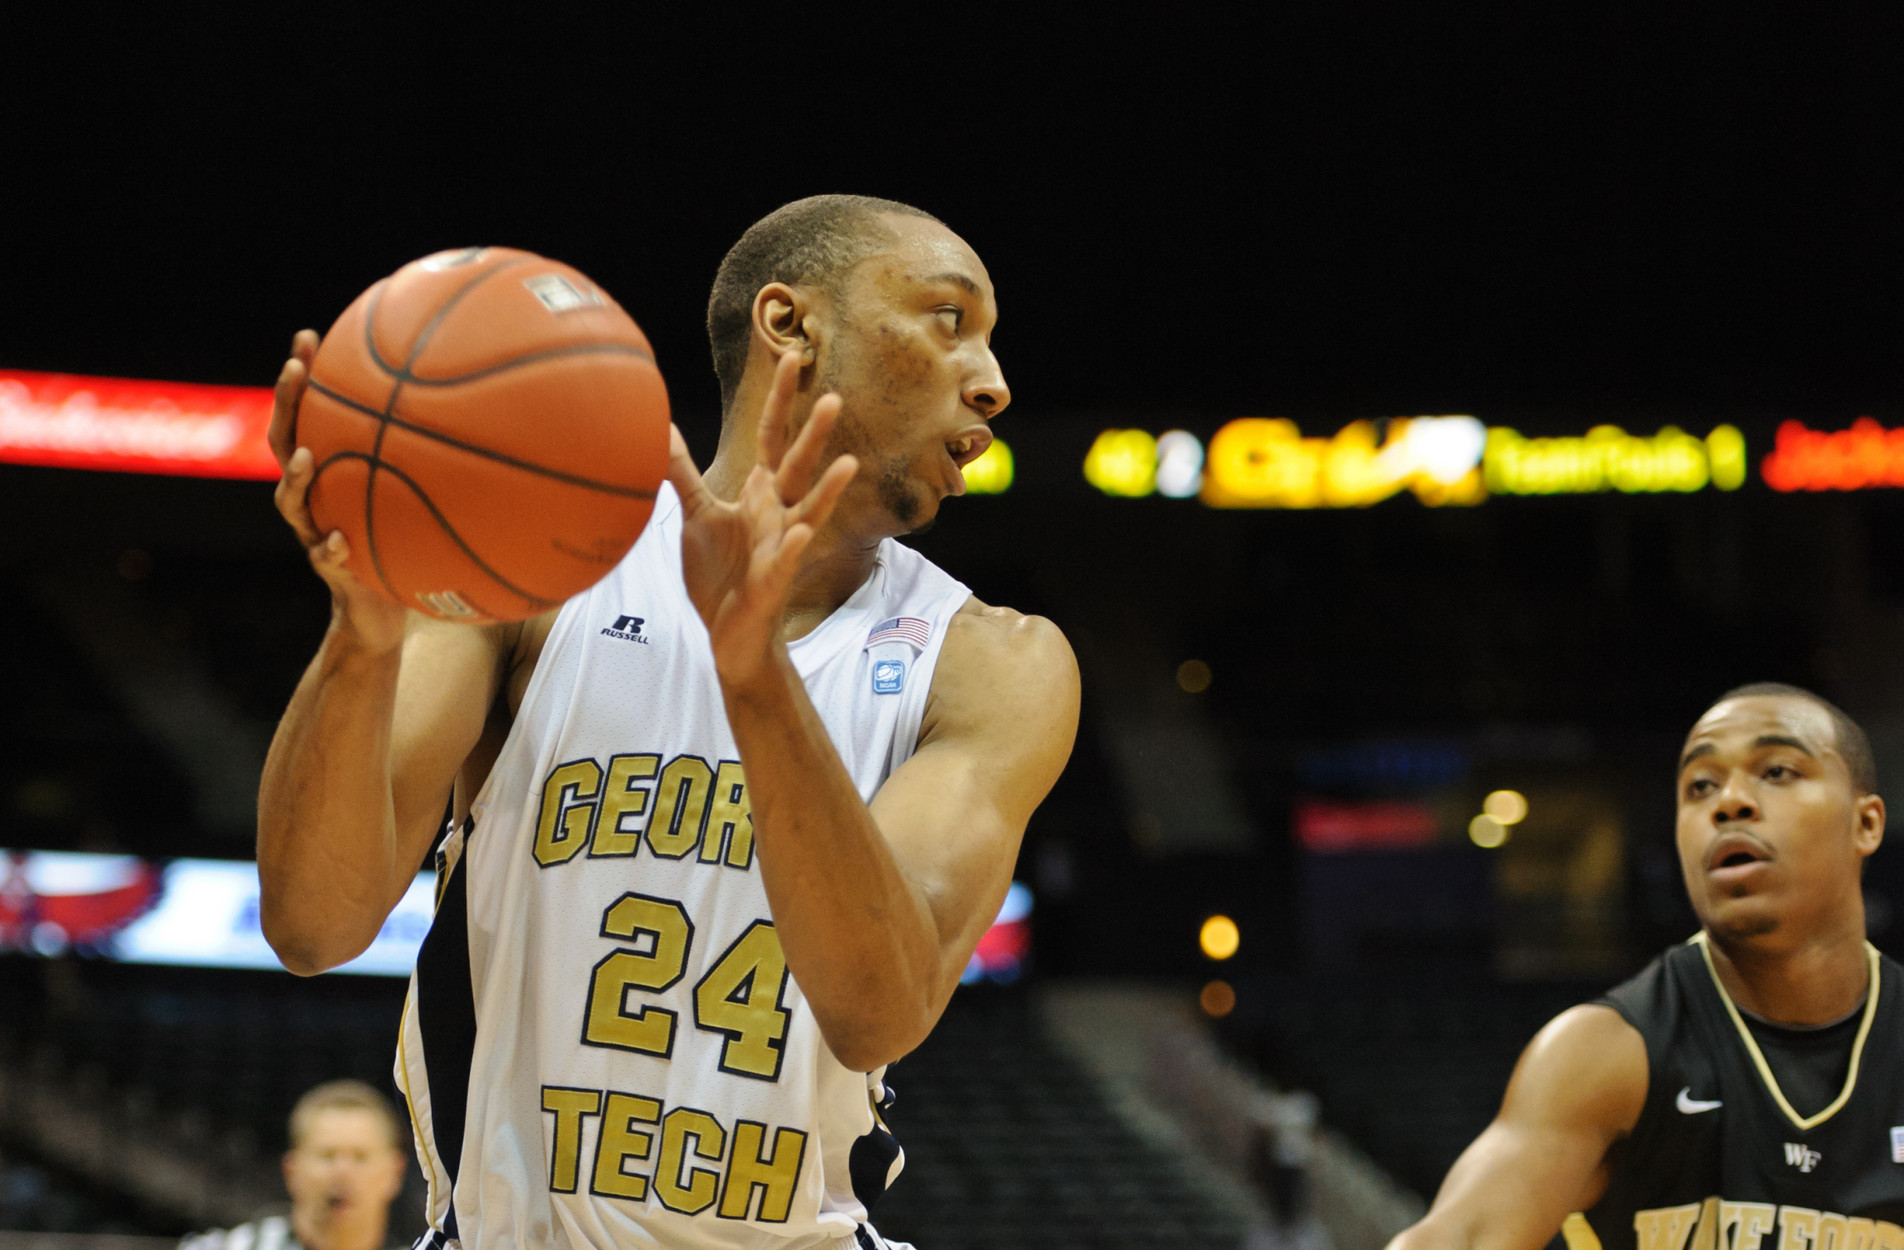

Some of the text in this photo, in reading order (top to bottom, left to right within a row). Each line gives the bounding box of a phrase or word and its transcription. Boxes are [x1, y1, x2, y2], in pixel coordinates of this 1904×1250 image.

[600, 627, 649, 645] RUSSELL
[532, 753, 759, 870] GEOR
[581, 891, 791, 1083] 24
[541, 1085, 808, 1223] TECH
[1784, 1142, 1822, 1173] WF
